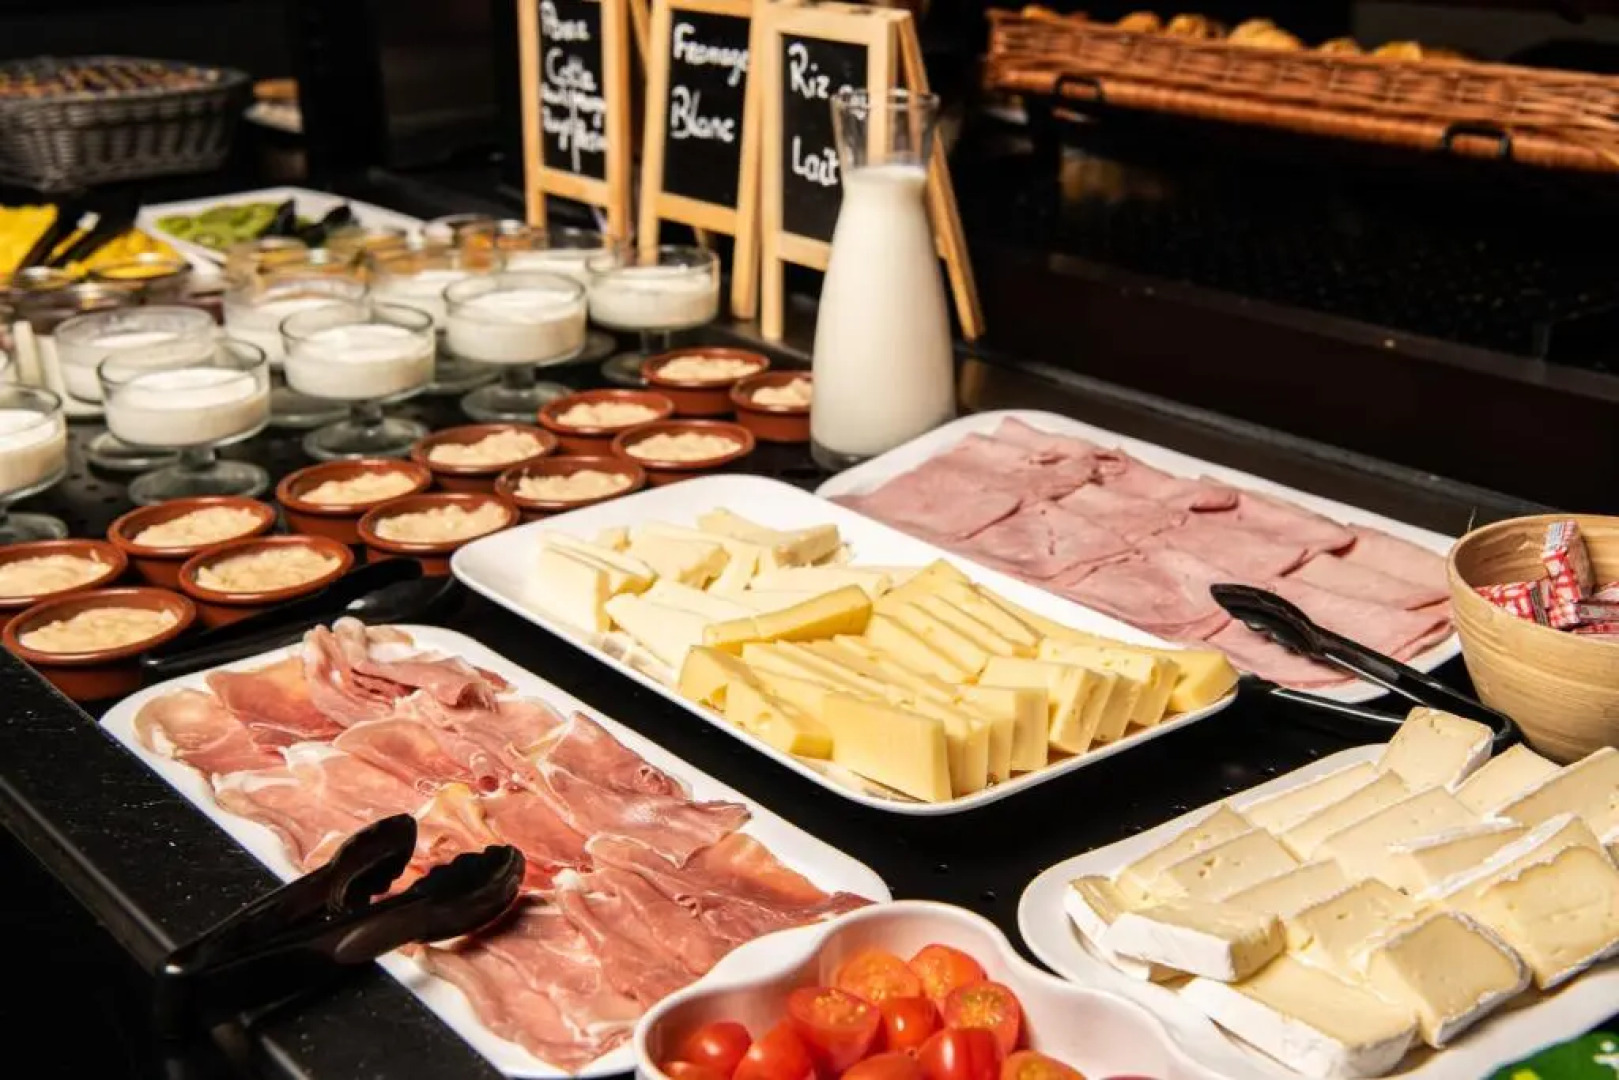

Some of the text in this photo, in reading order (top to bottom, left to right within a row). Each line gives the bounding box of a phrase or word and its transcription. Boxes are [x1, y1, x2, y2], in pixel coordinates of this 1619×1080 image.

[788, 43, 831, 99] Riz
[671, 85, 735, 143] Blanc
[792, 136, 839, 187] Lait
